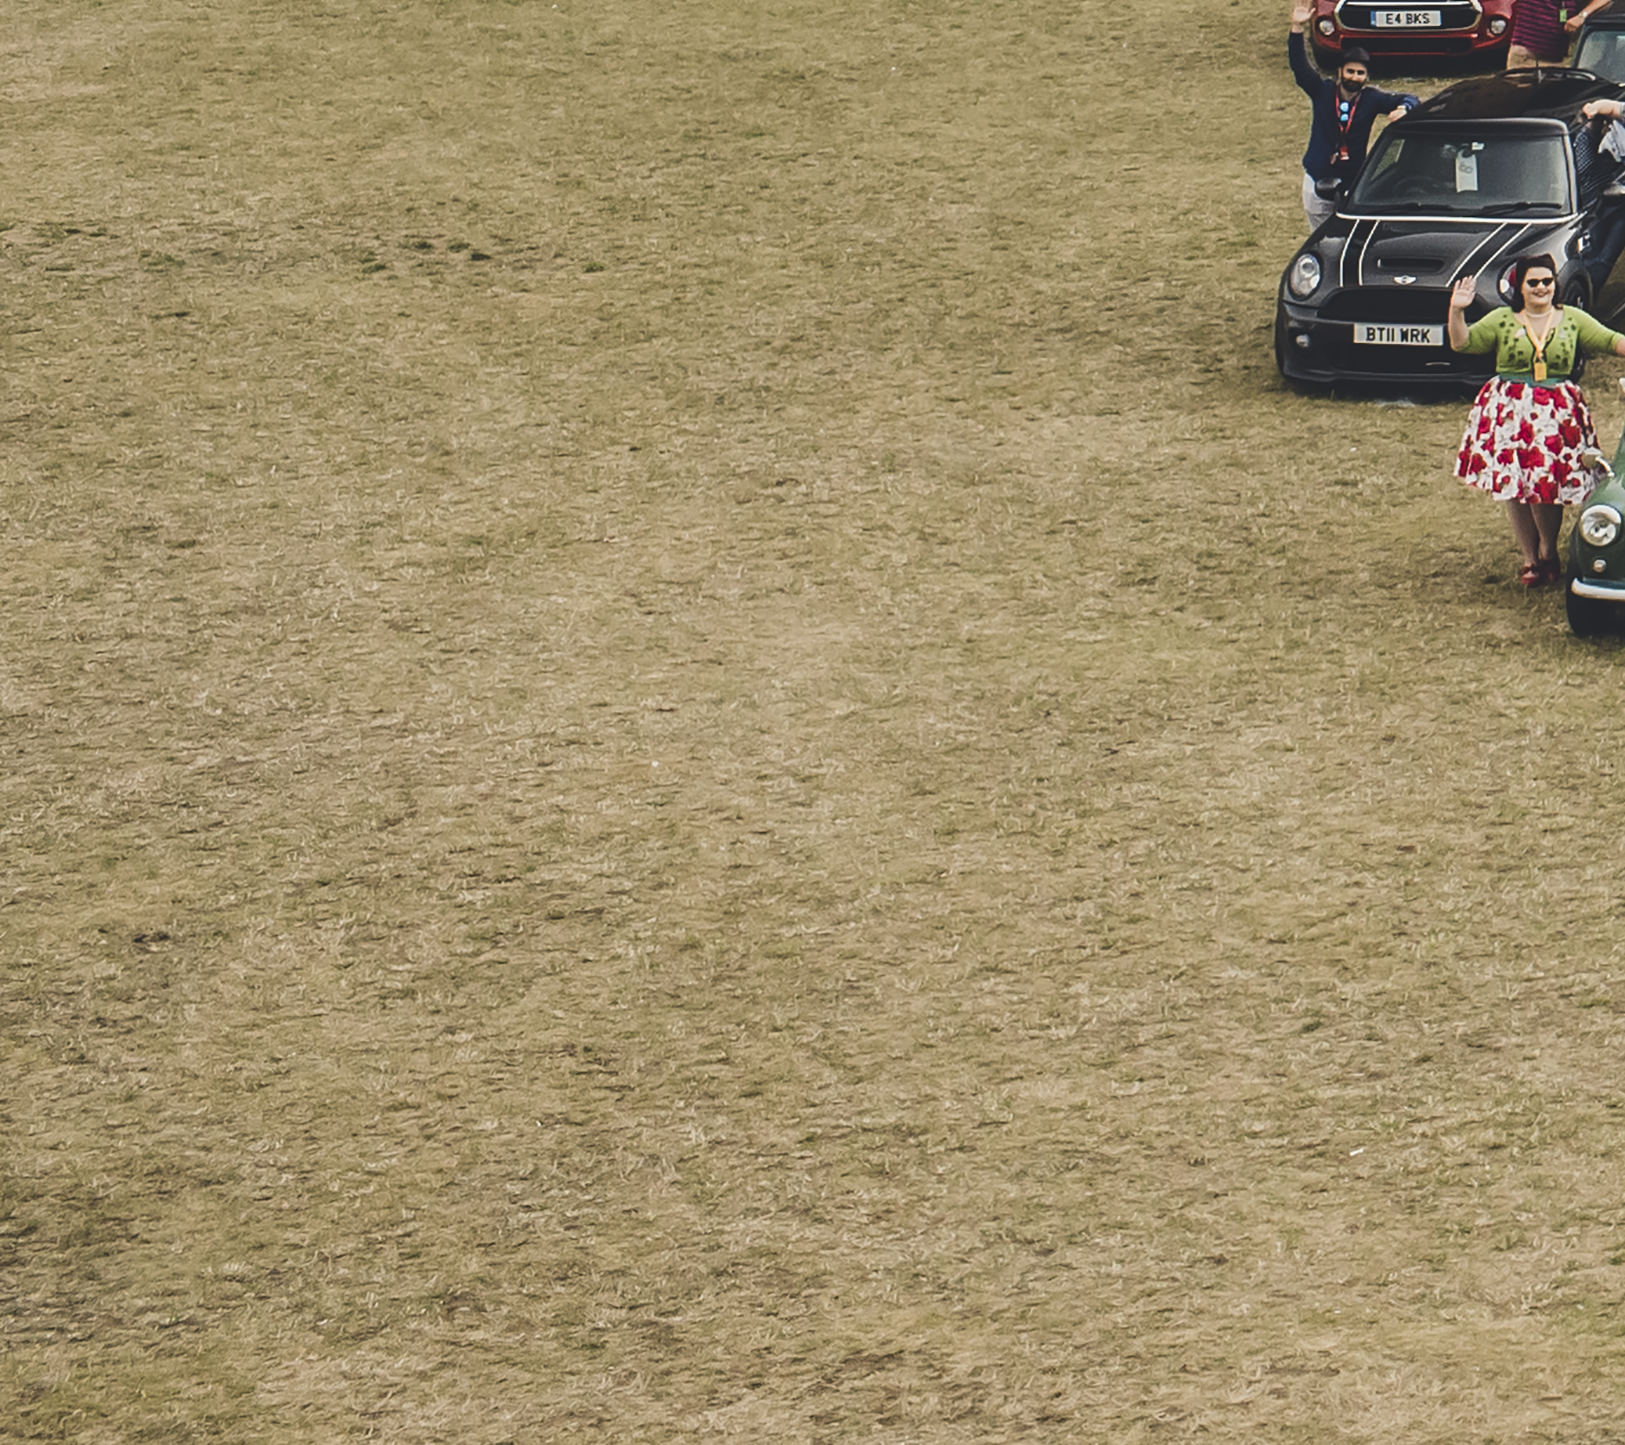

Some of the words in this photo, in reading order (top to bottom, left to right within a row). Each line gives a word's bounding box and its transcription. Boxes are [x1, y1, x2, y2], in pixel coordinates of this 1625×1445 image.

[1386, 14, 1400, 24] E4
[1406, 14, 1429, 23] BKS
[1401, 328, 1430, 343] WRK
